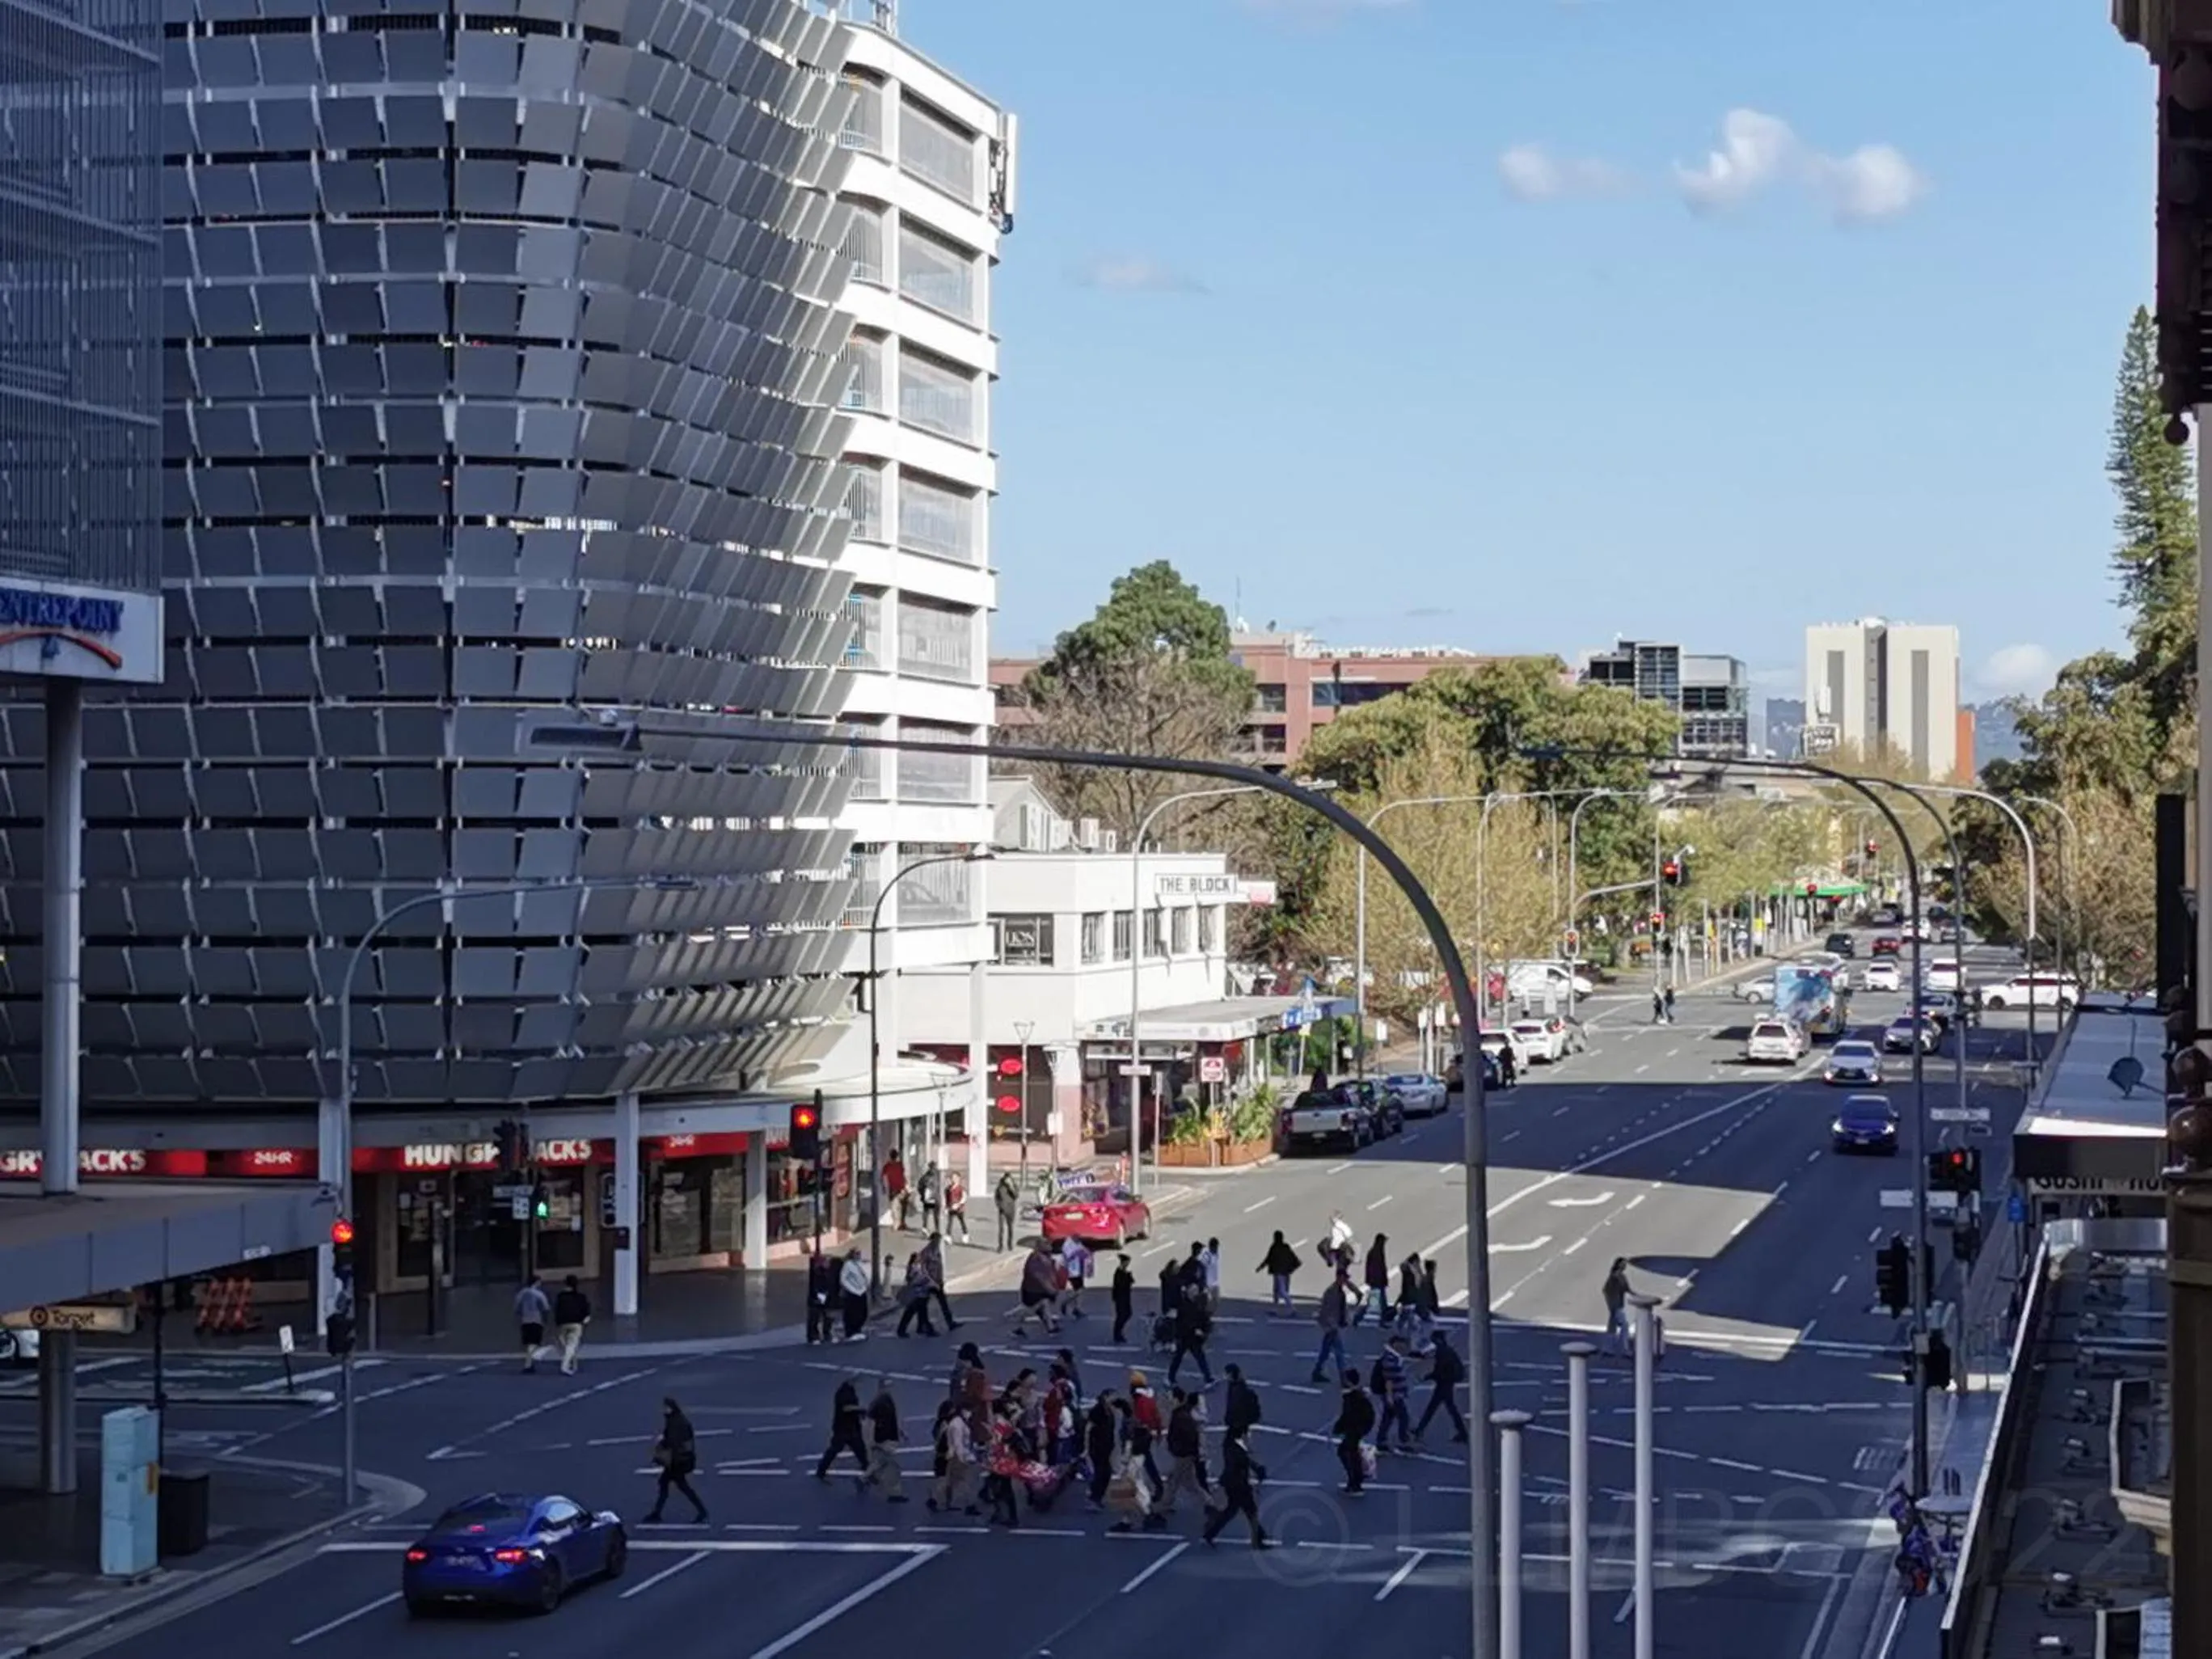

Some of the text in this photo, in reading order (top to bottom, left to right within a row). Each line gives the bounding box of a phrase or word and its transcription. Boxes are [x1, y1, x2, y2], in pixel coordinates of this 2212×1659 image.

[1159, 877, 1230, 893] THE BLOCK
[534, 1139, 593, 1163] ACKS
[52, 1308, 95, 1331] Target
